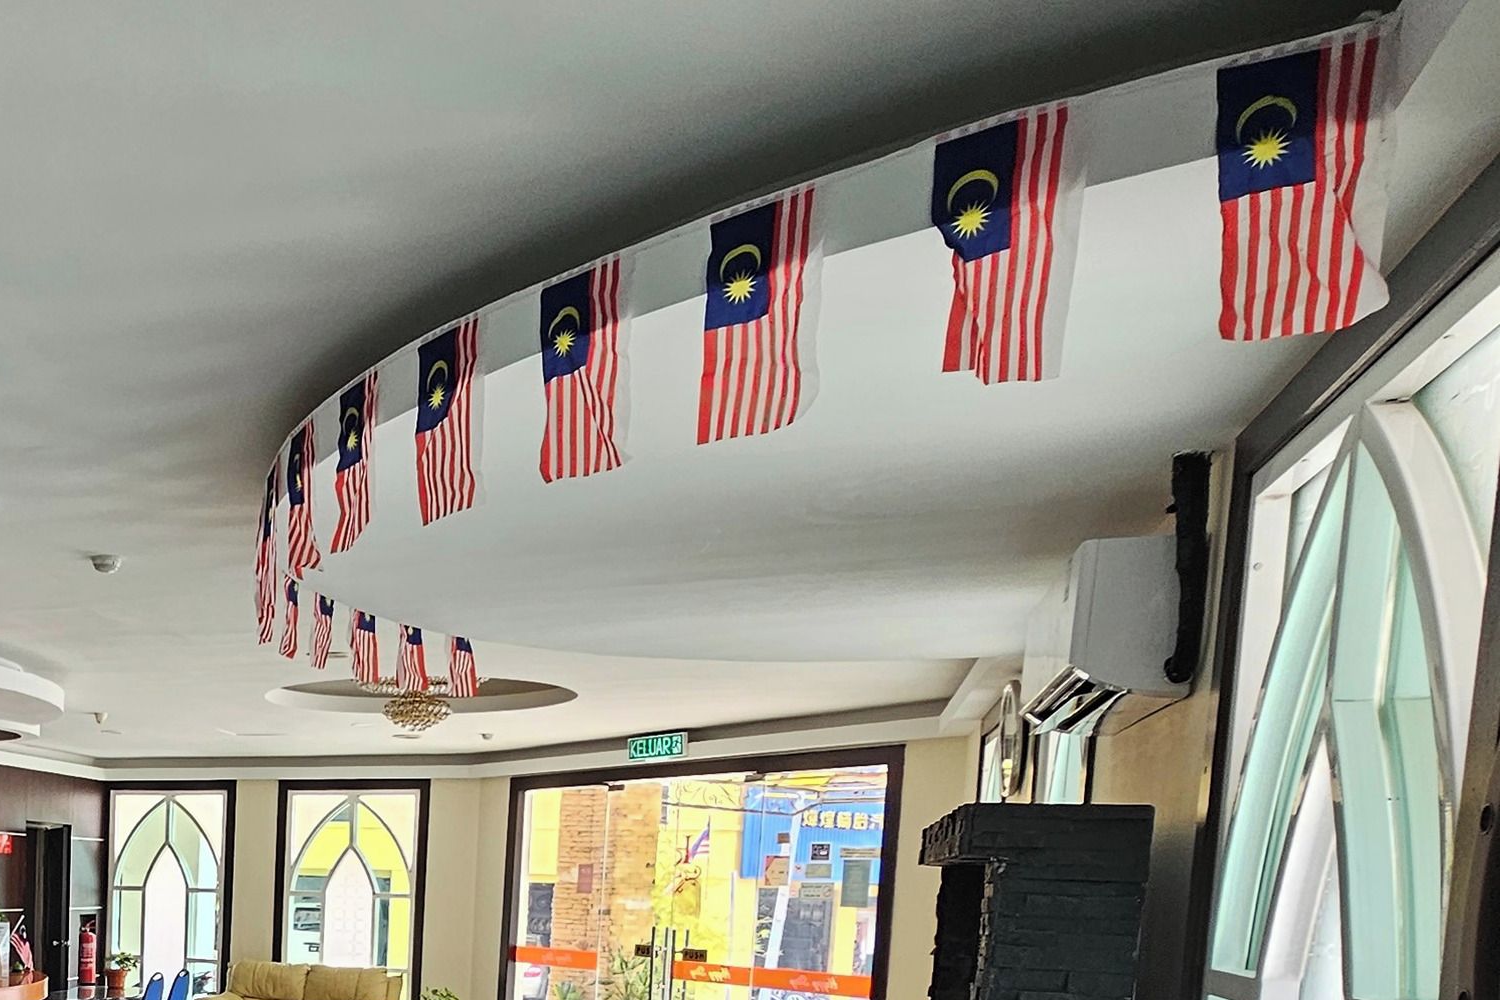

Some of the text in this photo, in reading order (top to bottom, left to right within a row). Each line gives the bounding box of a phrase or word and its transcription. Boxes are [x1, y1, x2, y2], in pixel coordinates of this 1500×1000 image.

[630, 737, 671, 758] KELUAR
[636, 946, 653, 956] PUS
[684, 950, 705, 960] PUSH
